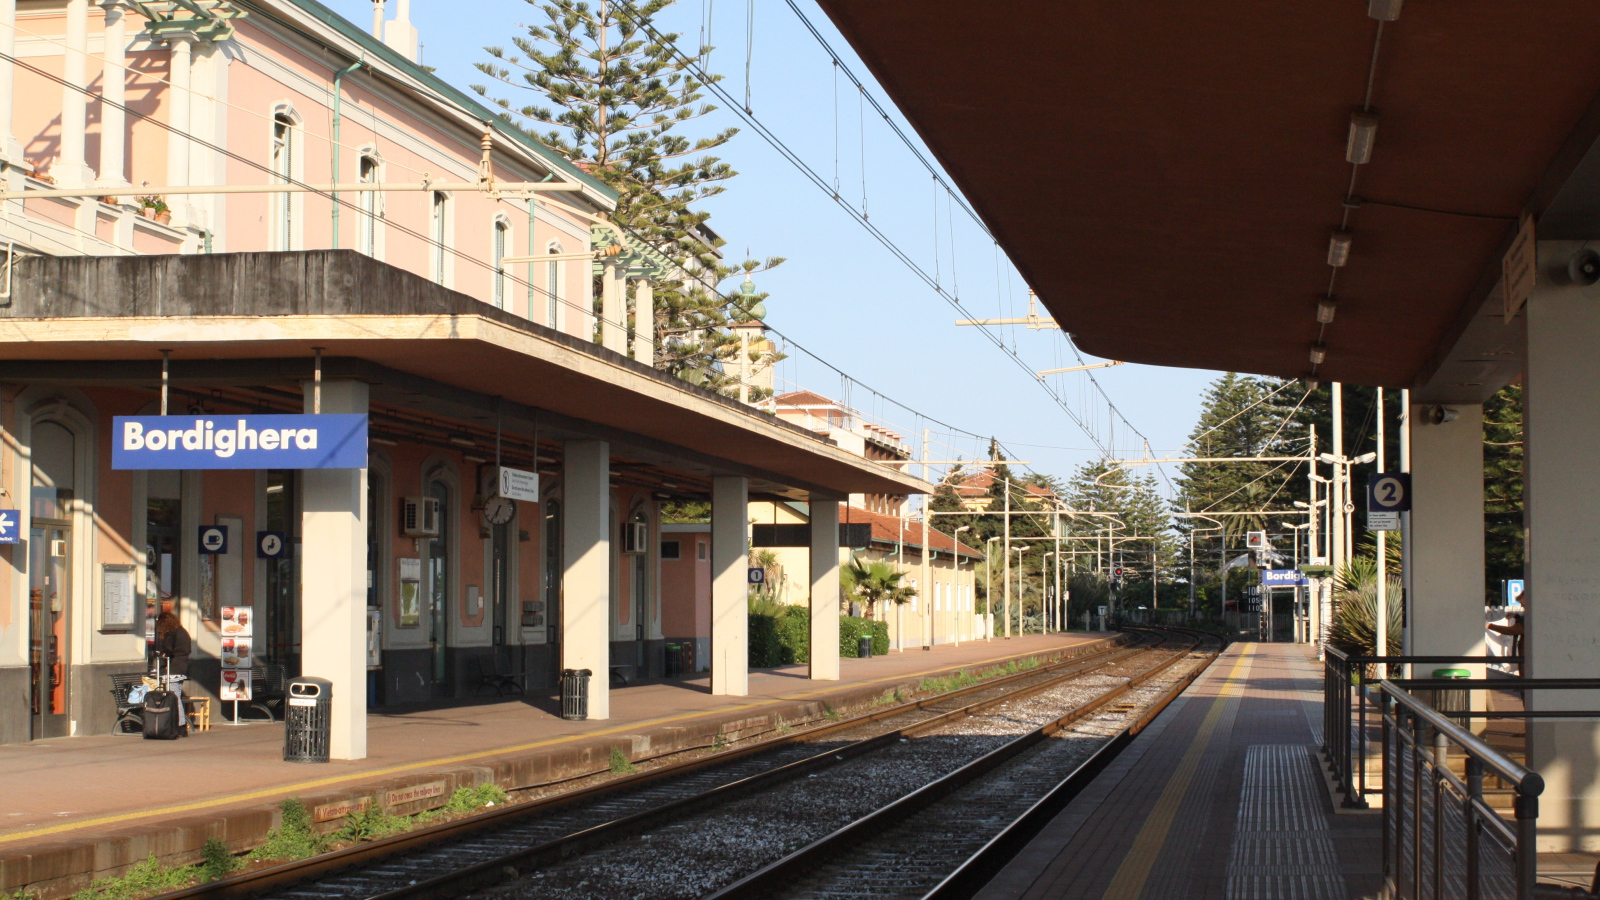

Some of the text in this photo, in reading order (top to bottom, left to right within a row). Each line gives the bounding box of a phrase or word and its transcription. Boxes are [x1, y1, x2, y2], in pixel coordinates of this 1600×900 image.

[123, 419, 318, 458] Bordighera
[1381, 482, 1397, 502] 2
[754, 571, 759, 580] 1
[1266, 570, 1307, 582] Bordigh
[1511, 582, 1522, 604] P
